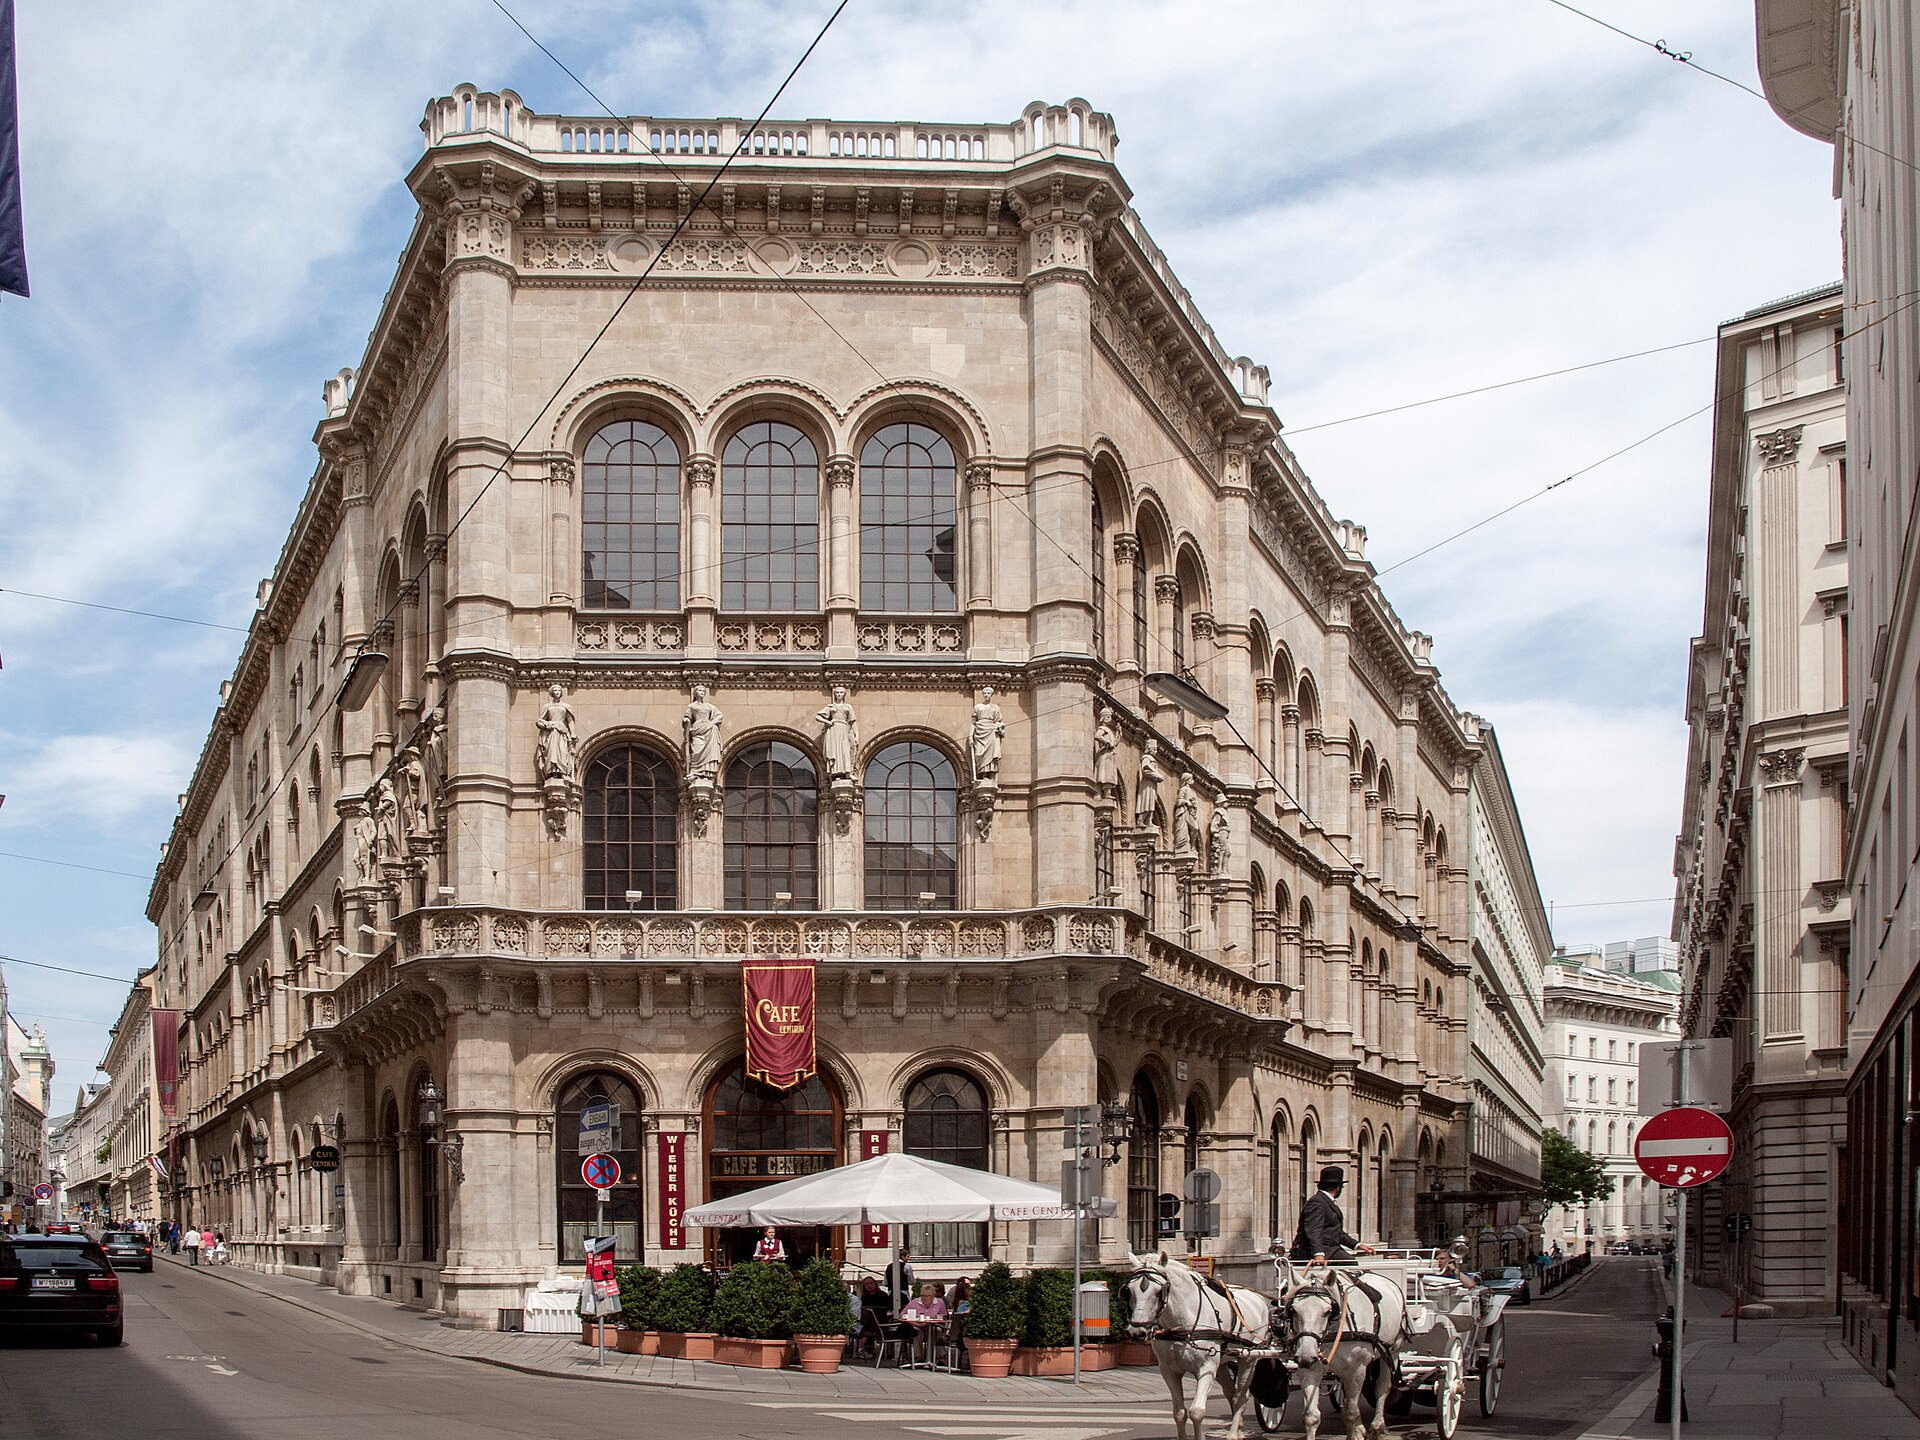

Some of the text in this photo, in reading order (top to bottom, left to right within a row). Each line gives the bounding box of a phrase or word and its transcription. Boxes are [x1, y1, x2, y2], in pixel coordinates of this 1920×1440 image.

[755, 998, 800, 1036] CAFE
[779, 1025, 805, 1034] CENTRAL
[589, 1111, 607, 1124] EINBAHN
[723, 1156, 827, 1175] CAFE CENTRAL
[666, 1135, 678, 1246] WIENER KÜCHE
[687, 1212, 742, 1224] CAFE CENTRAL
[1001, 1207, 1028, 1217] CAFE
